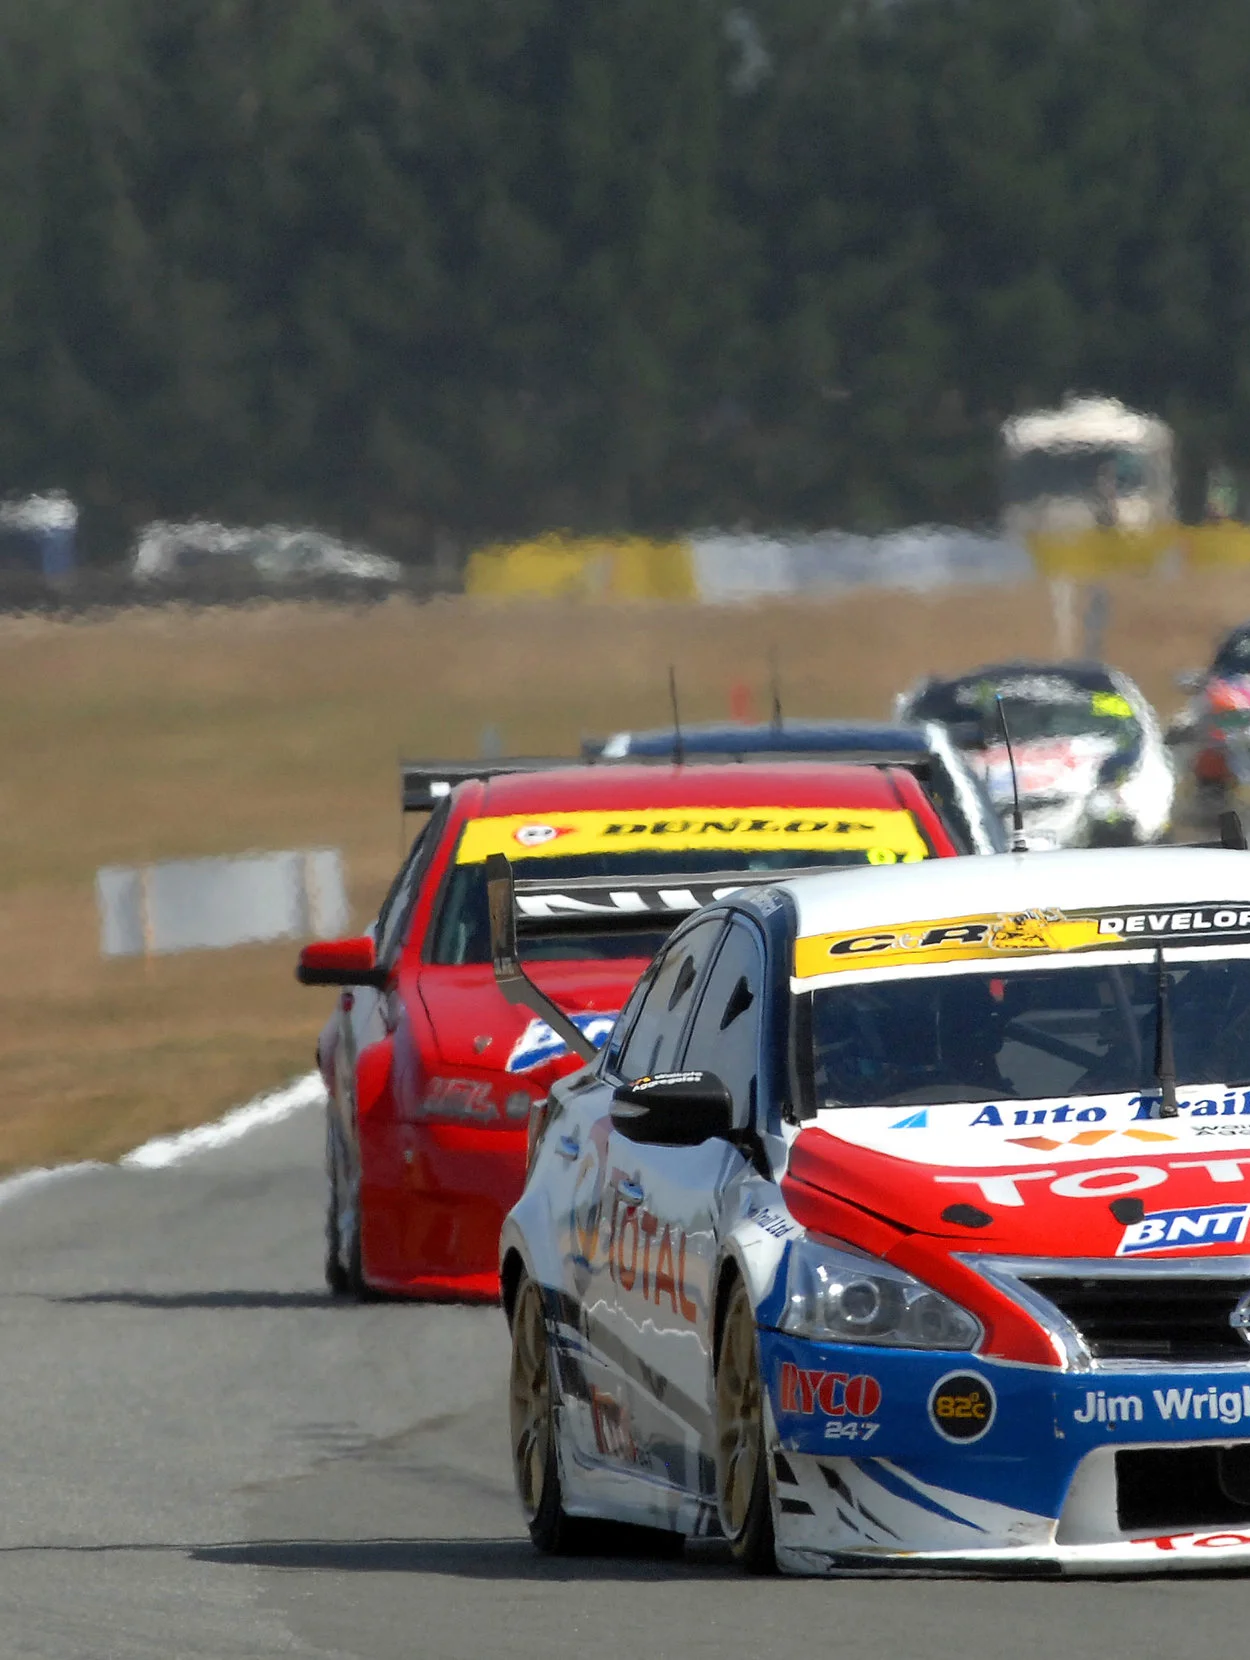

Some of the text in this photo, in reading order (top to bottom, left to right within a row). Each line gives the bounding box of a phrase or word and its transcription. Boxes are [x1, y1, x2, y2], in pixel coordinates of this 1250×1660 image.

[602, 818, 876, 836] DUNLOP
[968, 1103, 1108, 1127] Auto
[1130, 1210, 1248, 1246] BNT
[780, 1361, 882, 1418] RYCO
[1073, 1390, 1143, 1423] Jim
